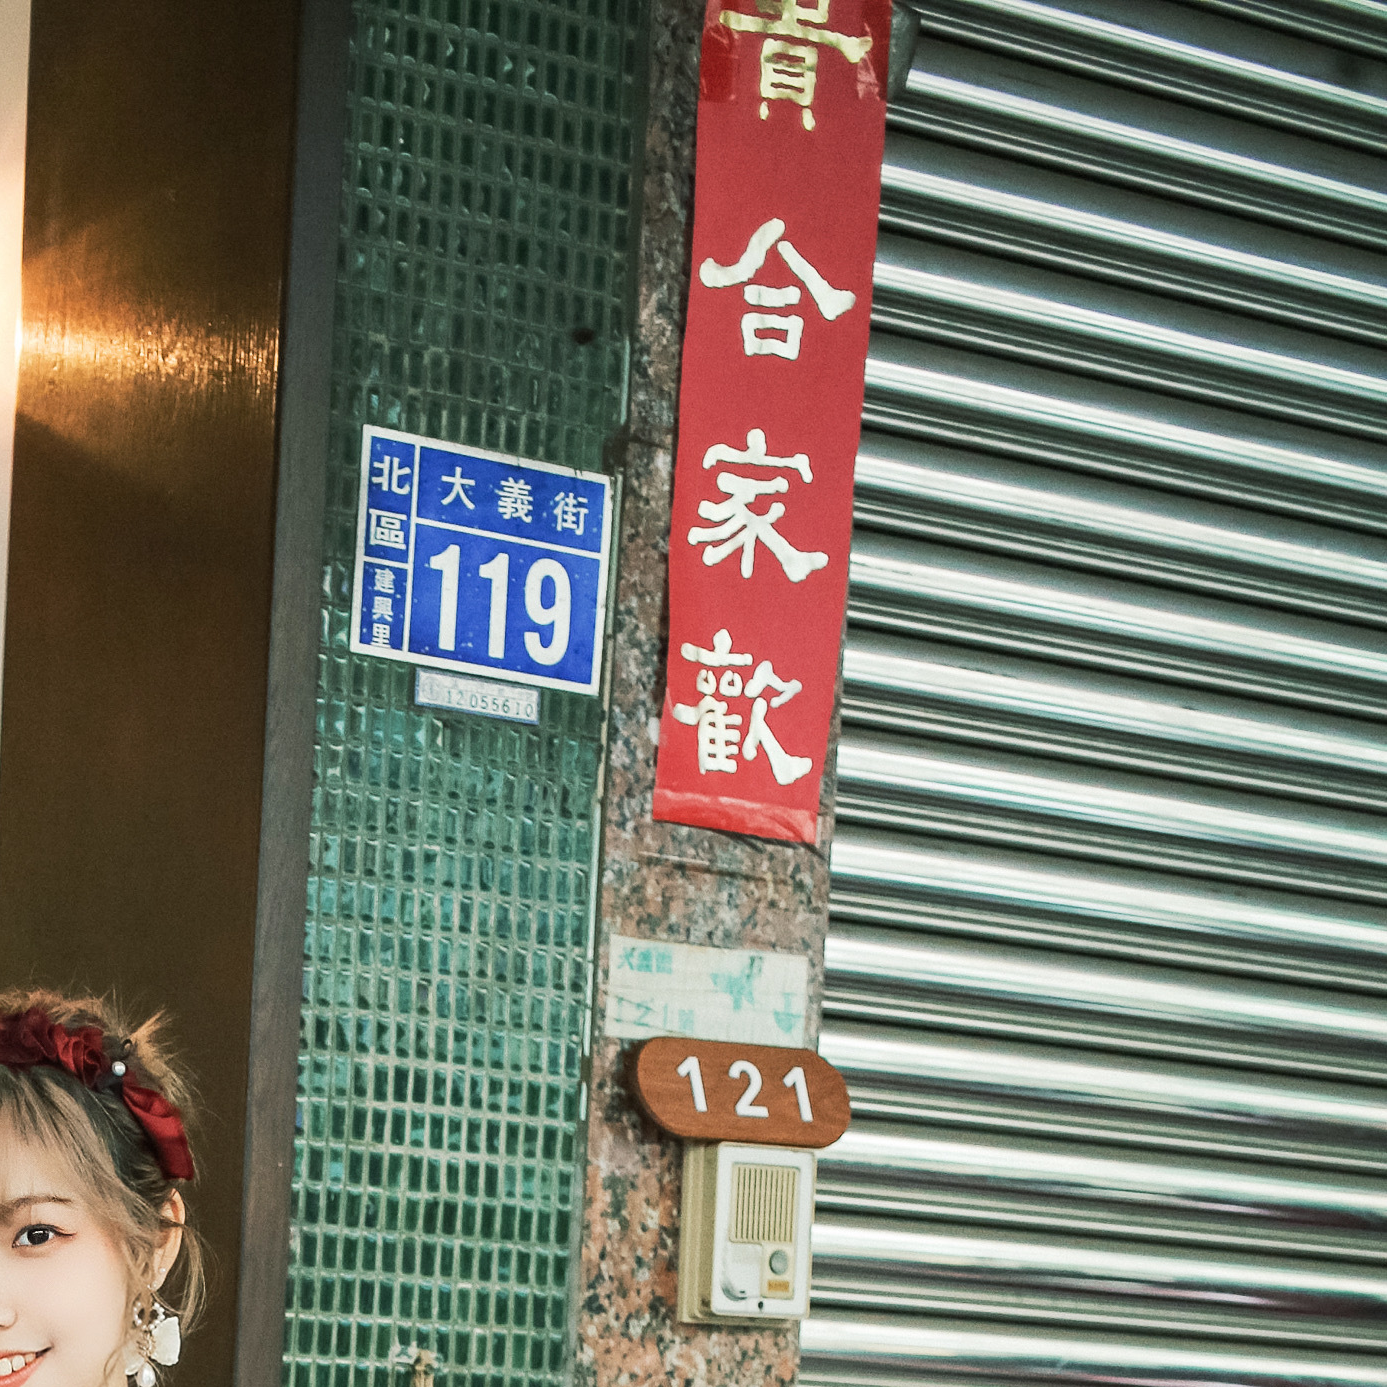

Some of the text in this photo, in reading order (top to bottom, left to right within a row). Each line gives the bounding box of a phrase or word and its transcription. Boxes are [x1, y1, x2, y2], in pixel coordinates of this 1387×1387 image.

[368, 455, 412, 550] 北區
[440, 466, 589, 536] 大義街
[429, 544, 572, 666] 119
[677, 1056, 814, 1123] 121
